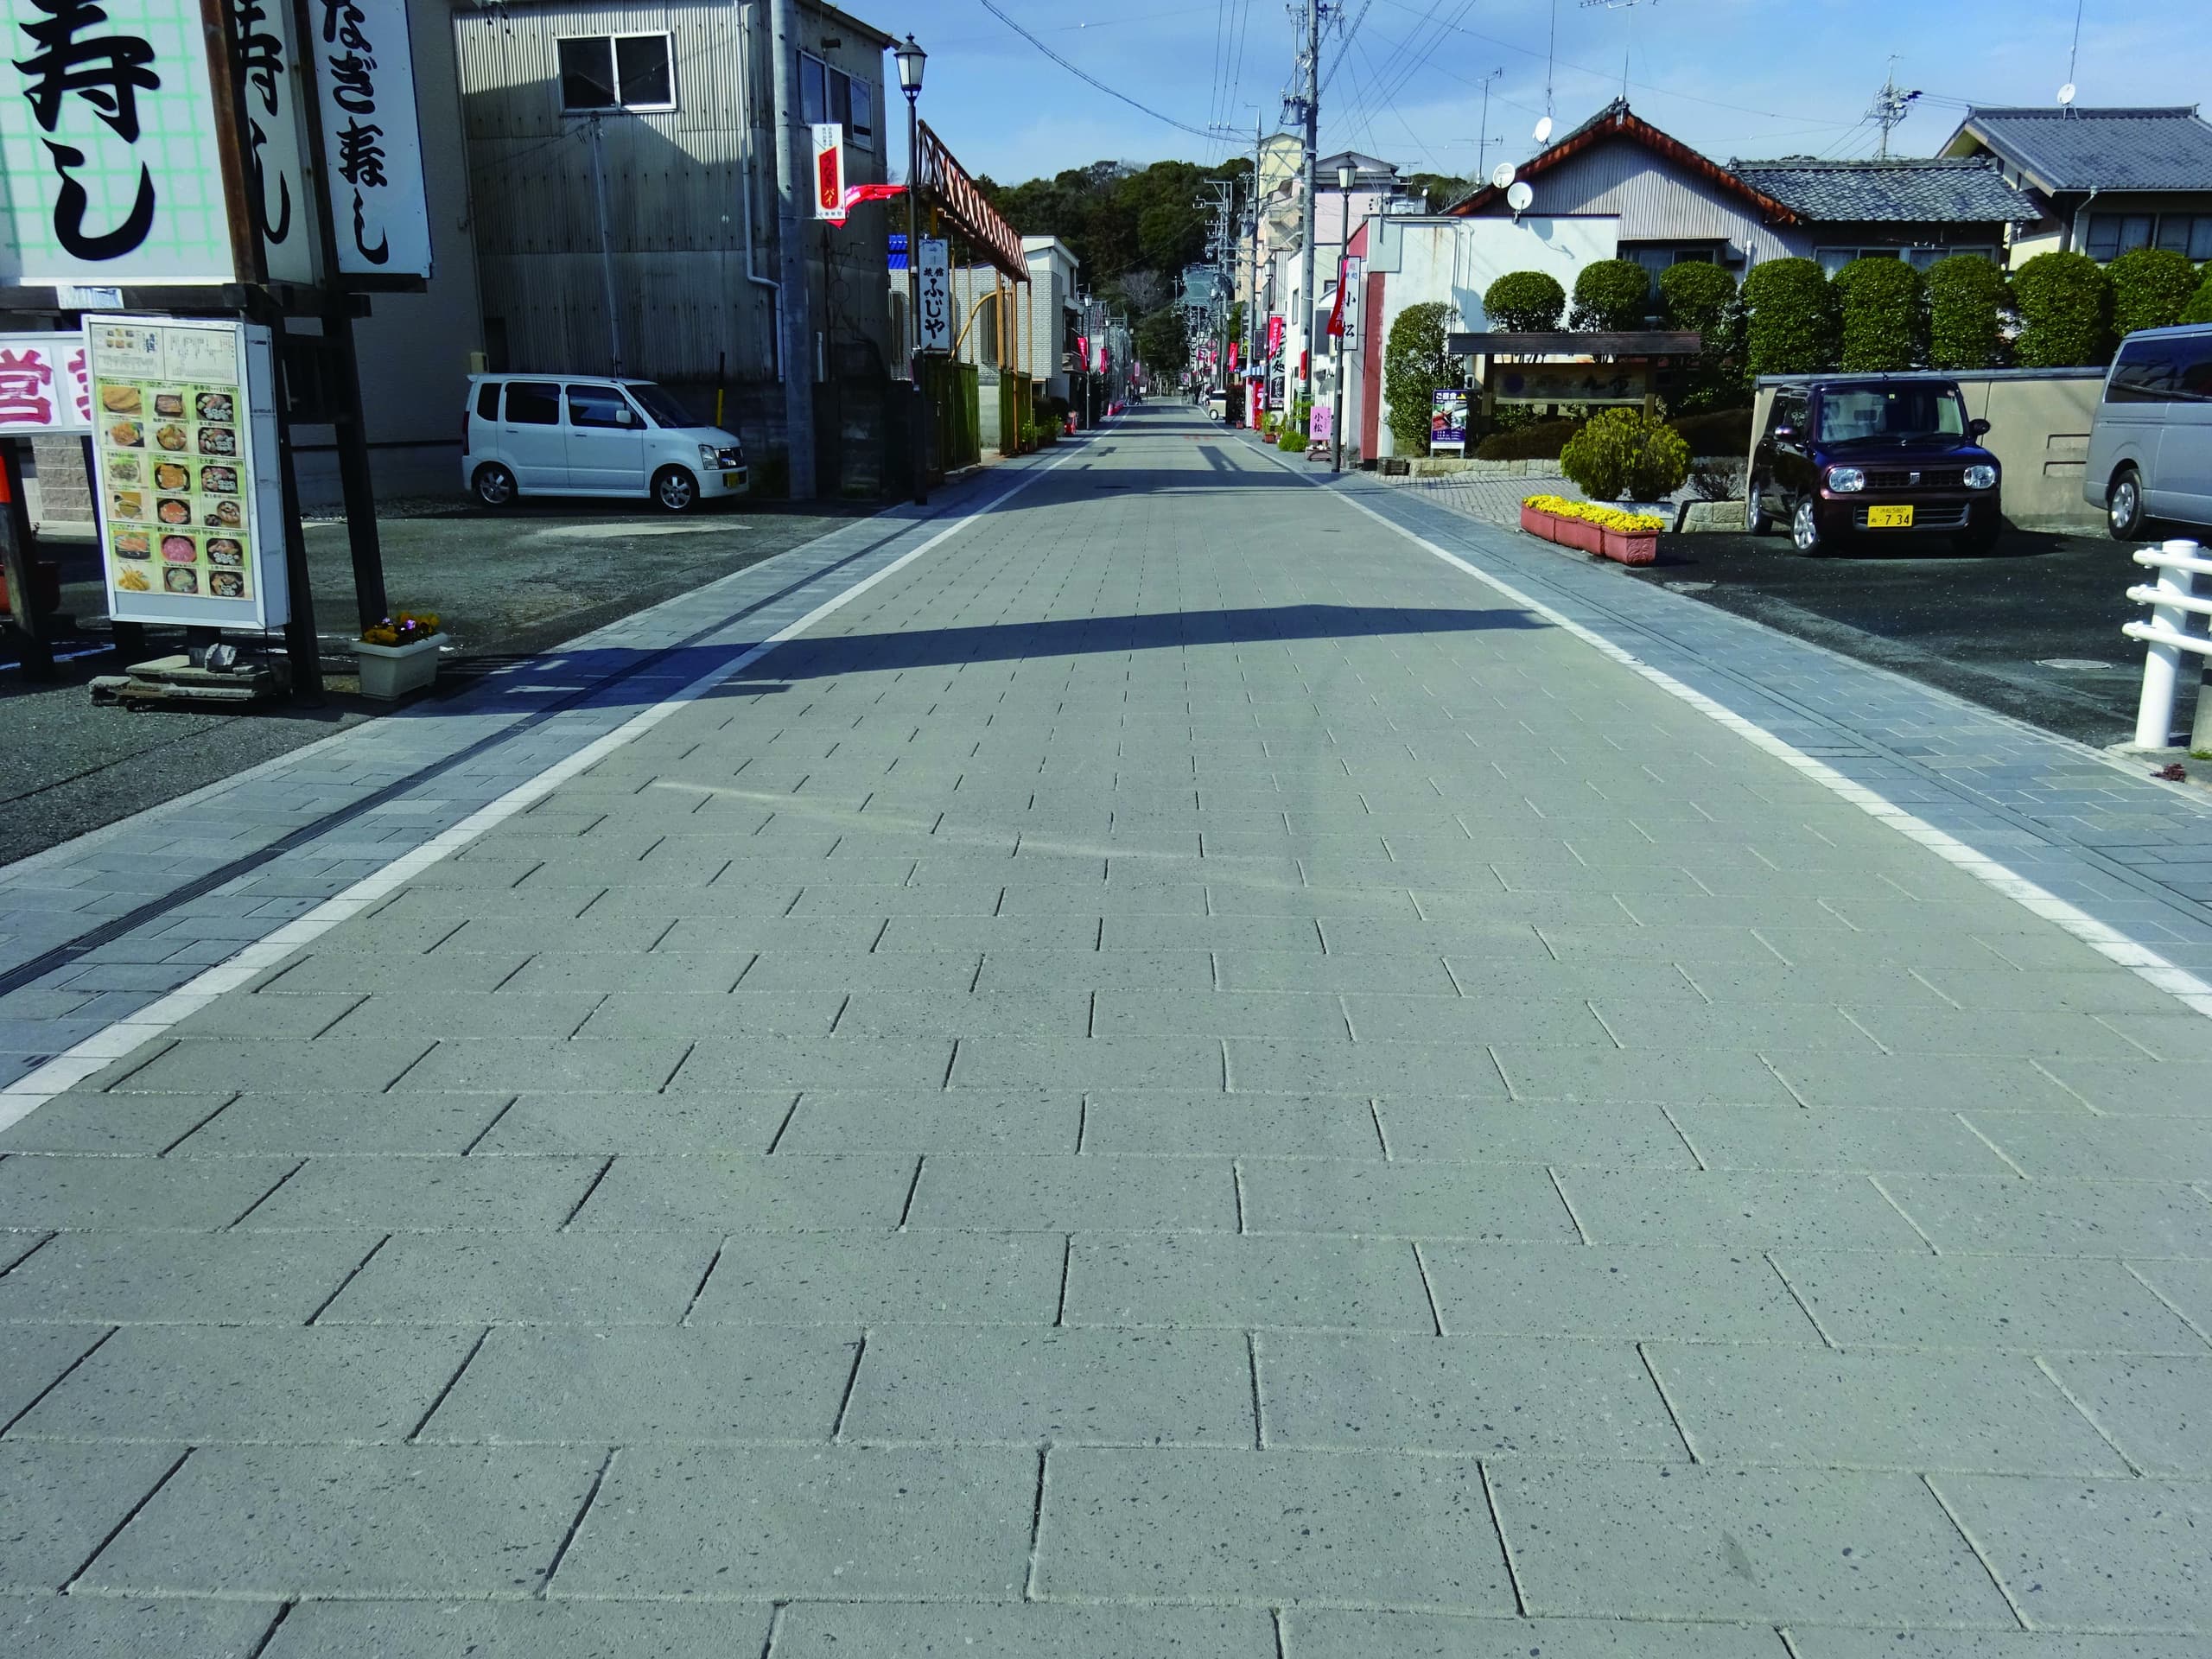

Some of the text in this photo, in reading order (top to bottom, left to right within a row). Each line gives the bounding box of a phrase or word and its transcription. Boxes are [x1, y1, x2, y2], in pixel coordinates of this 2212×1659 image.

[12, 0, 161, 261] 寿し
[924, 277, 945, 340] ふじや
[1313, 412, 1324, 433] 小松
